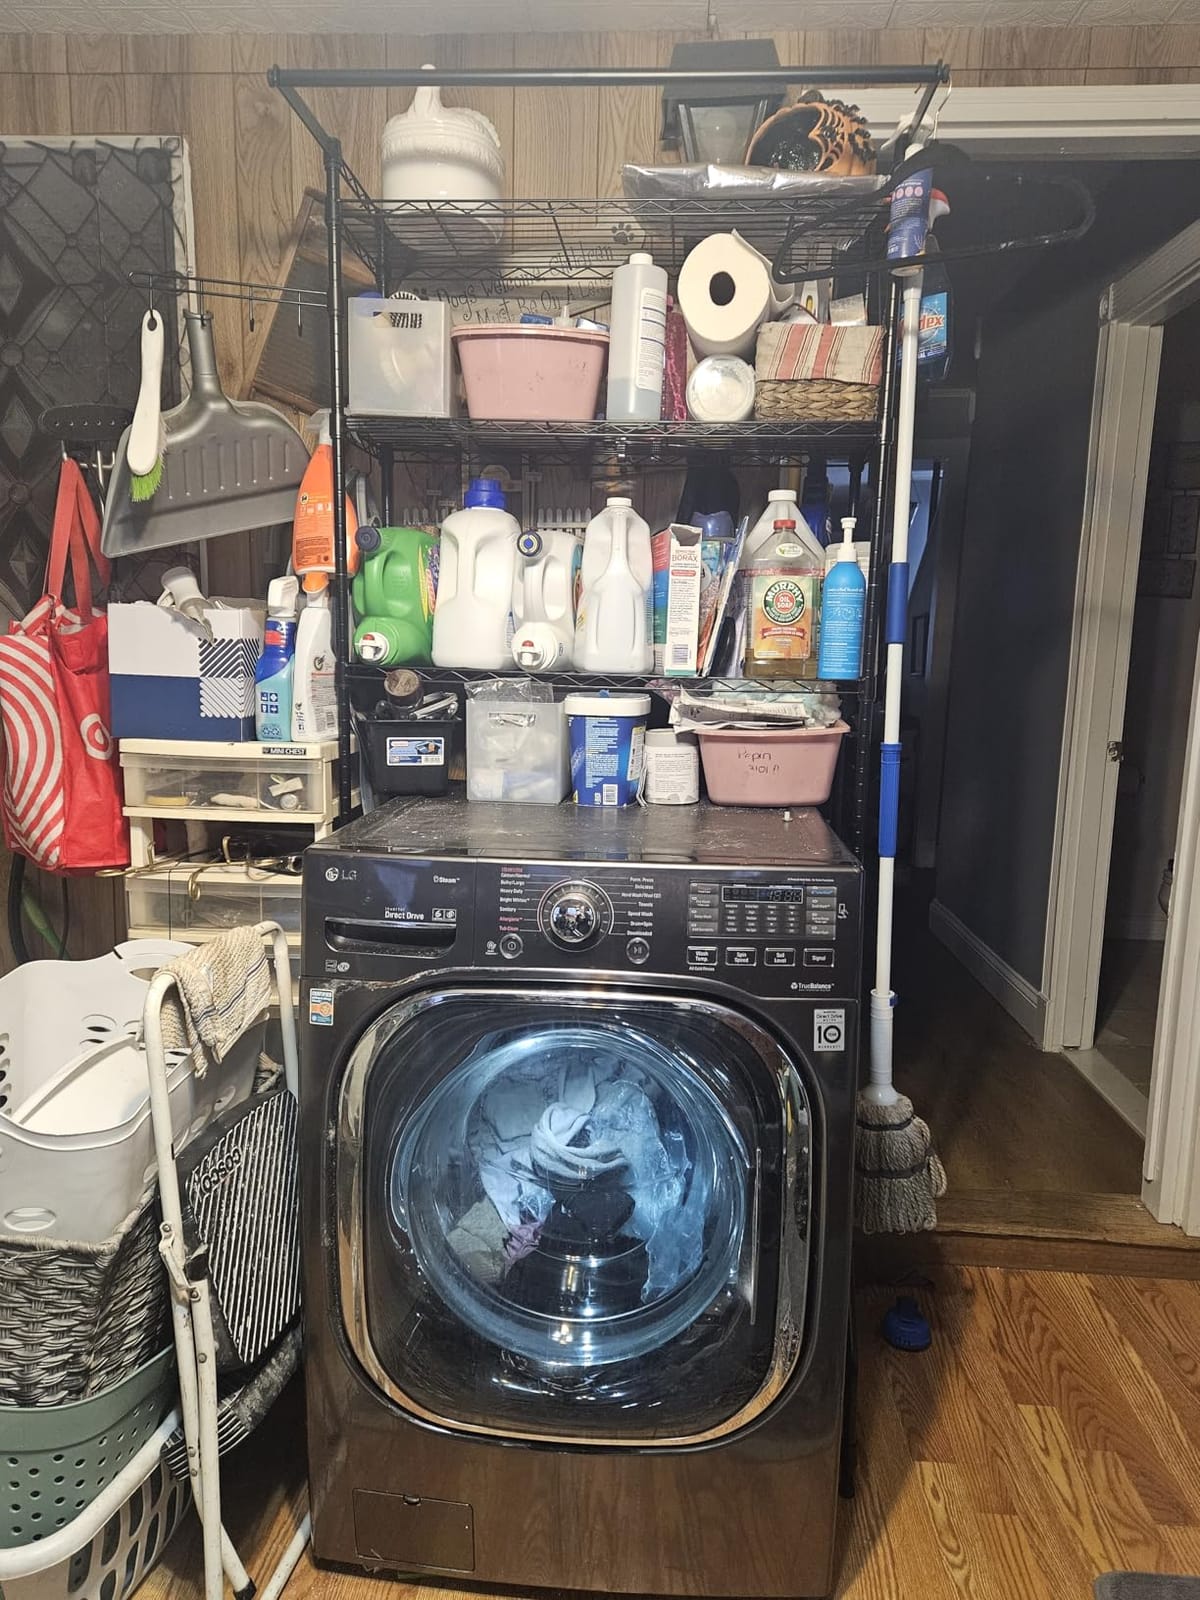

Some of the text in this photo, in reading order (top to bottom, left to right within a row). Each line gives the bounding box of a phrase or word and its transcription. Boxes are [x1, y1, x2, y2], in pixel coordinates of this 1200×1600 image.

[766, 581, 803, 602] MURPHY
[384, 911, 425, 921] Direct Drive
[817, 1025, 842, 1044] 10
[200, 1145, 242, 1194] COSCO
